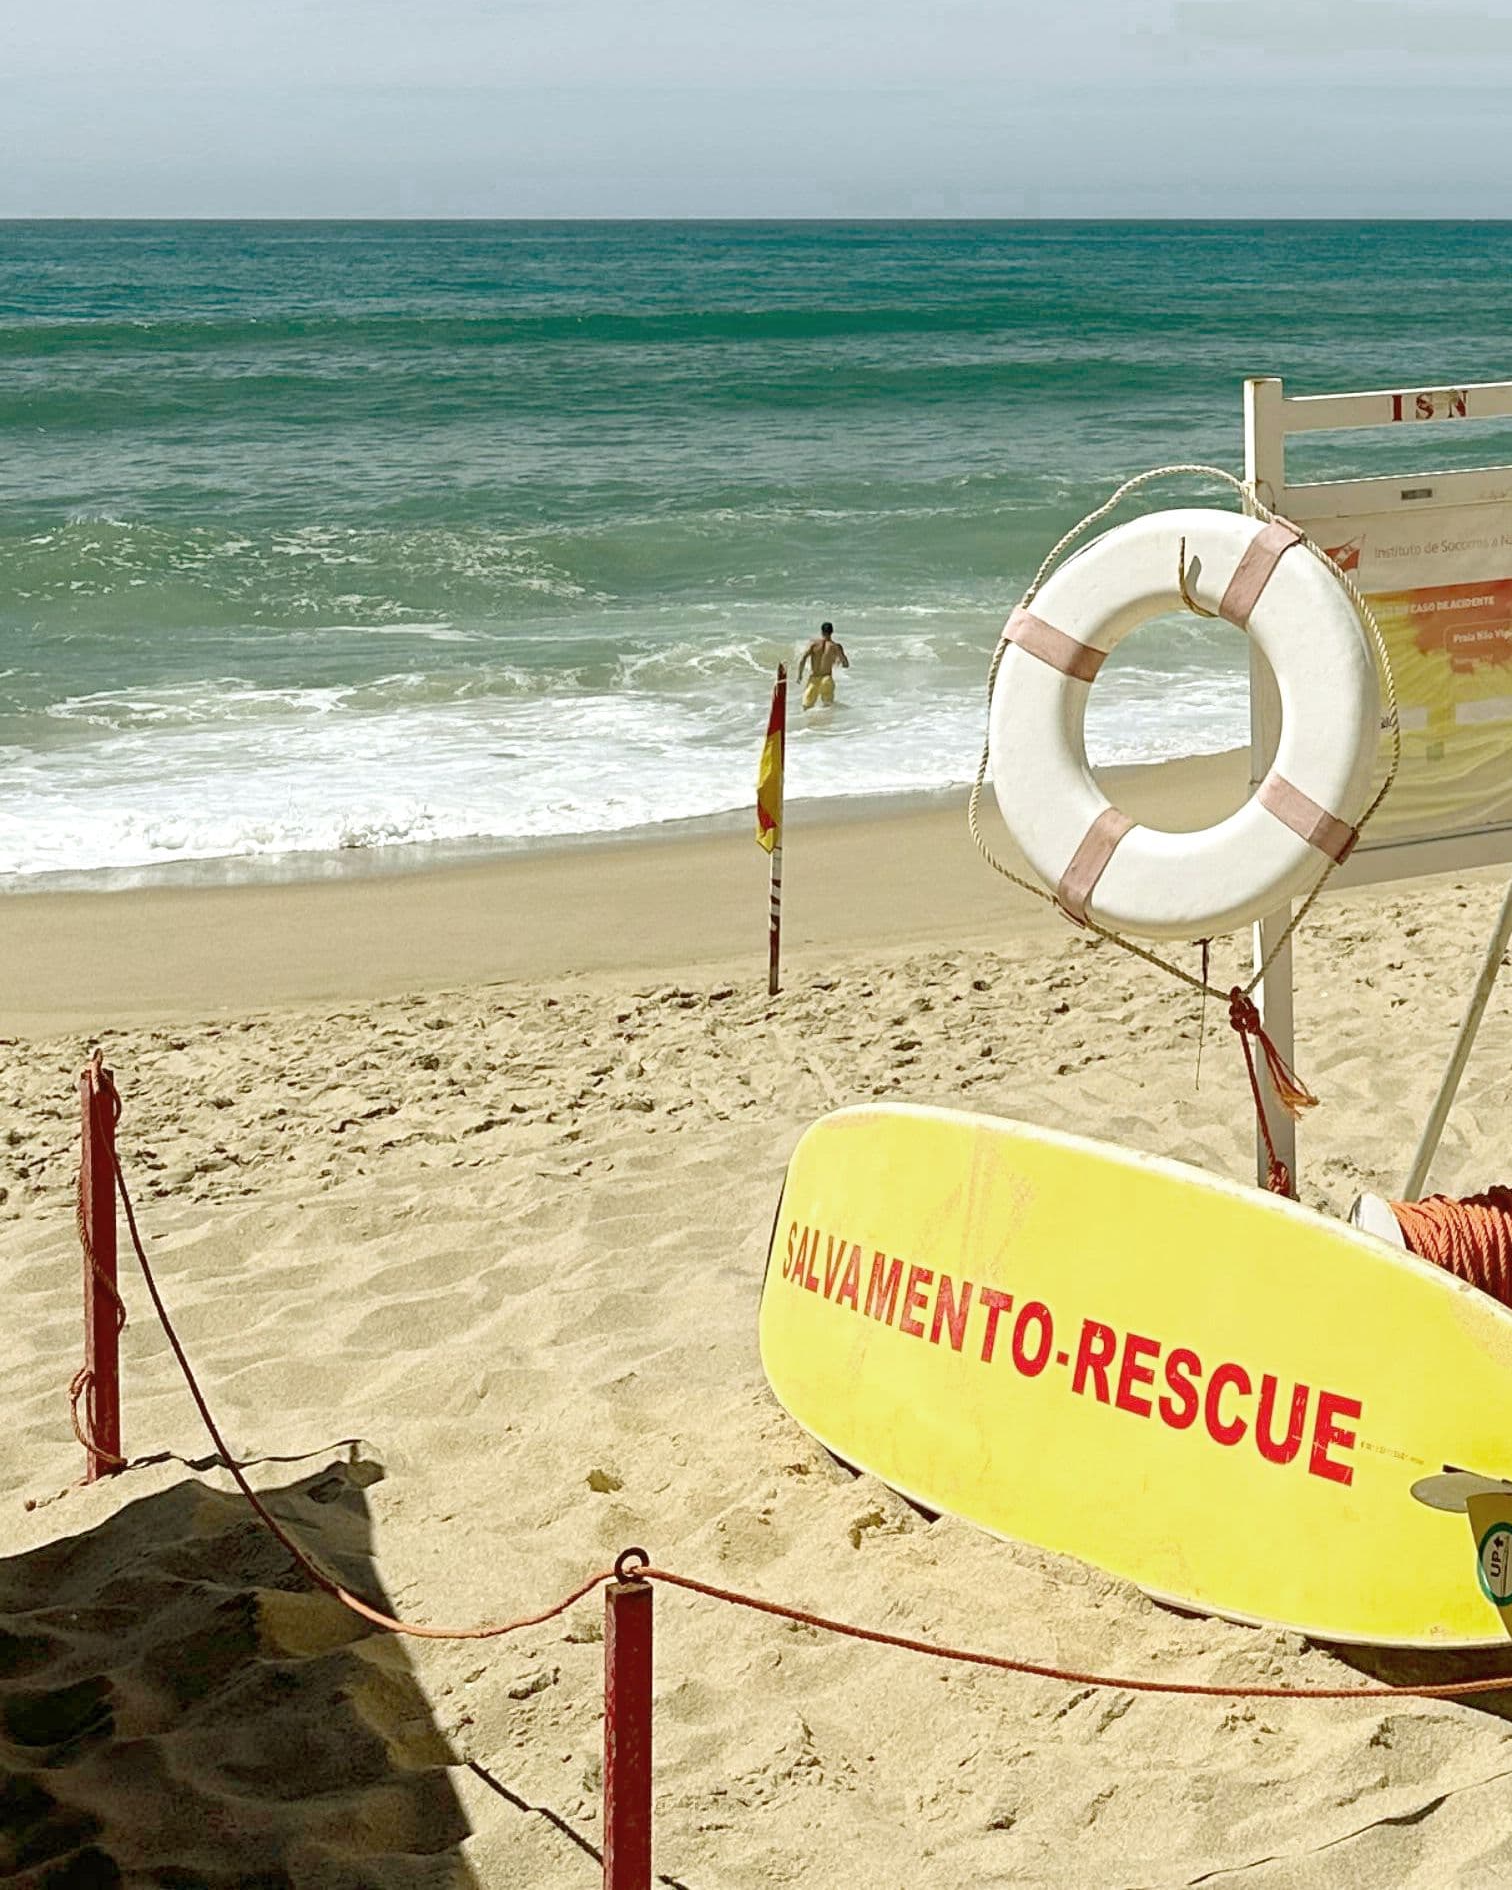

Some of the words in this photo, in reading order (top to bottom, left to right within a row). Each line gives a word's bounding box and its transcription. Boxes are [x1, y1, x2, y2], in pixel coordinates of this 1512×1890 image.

[1424, 541, 1440, 555] de
[1410, 601, 1434, 615] CASO
[1450, 595, 1495, 610] ACIDENTE
[1490, 1549, 1502, 1578] UP
